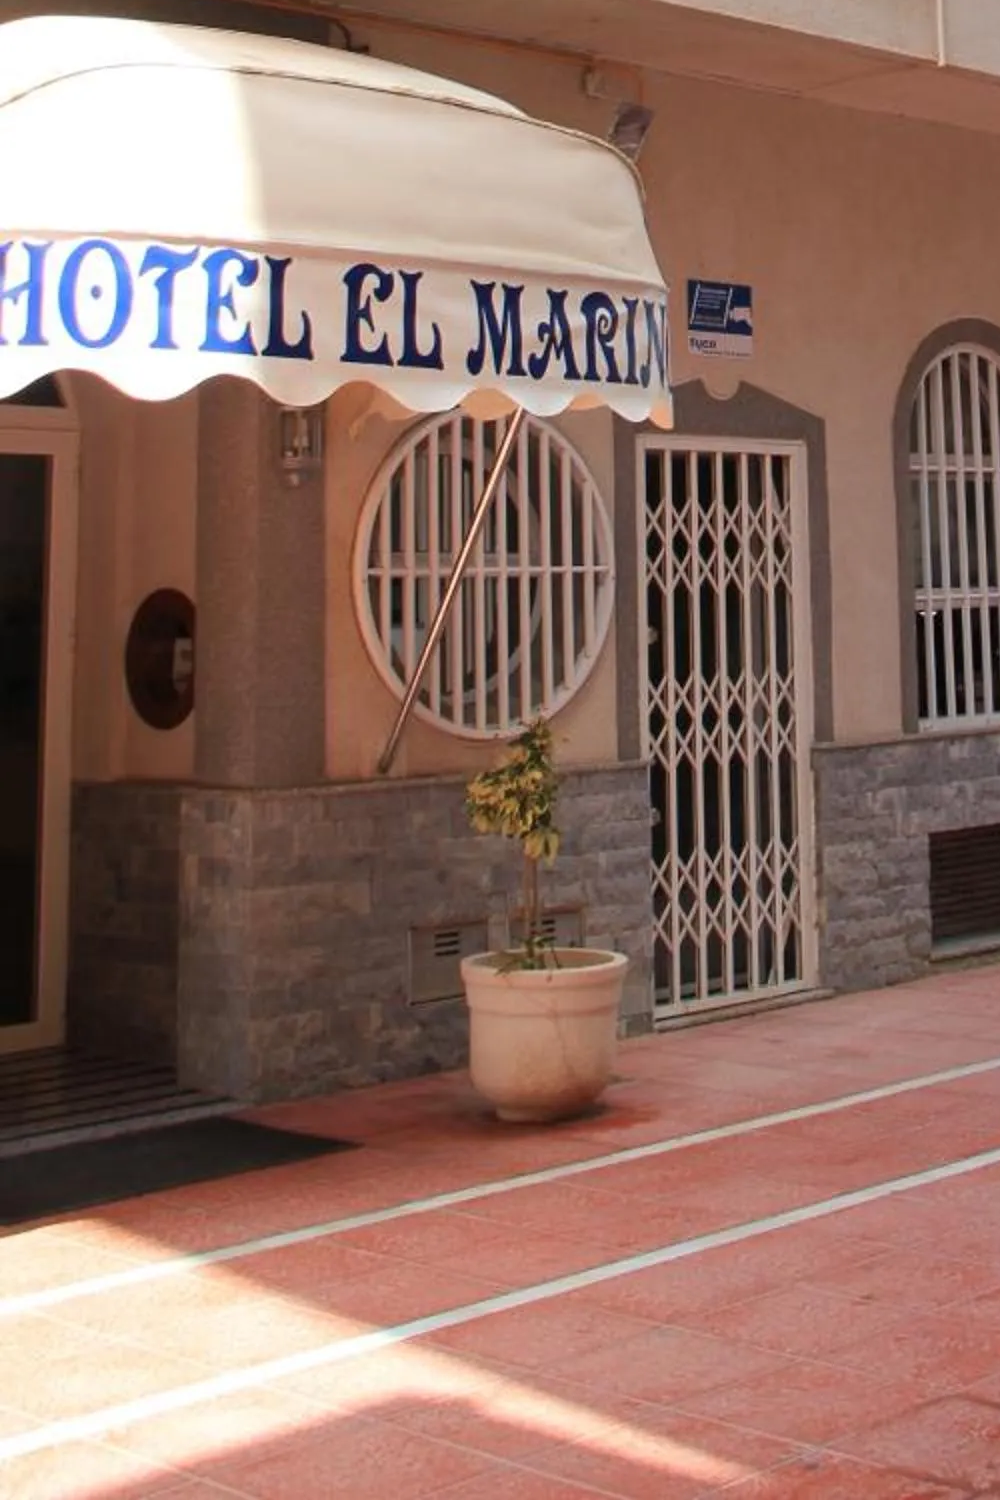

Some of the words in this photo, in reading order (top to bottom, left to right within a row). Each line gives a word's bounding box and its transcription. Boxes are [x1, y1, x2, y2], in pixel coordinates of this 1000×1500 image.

[0, 239, 313, 361] HOTEL
[339, 263, 443, 371] EL
[467, 280, 669, 389] MARIN
